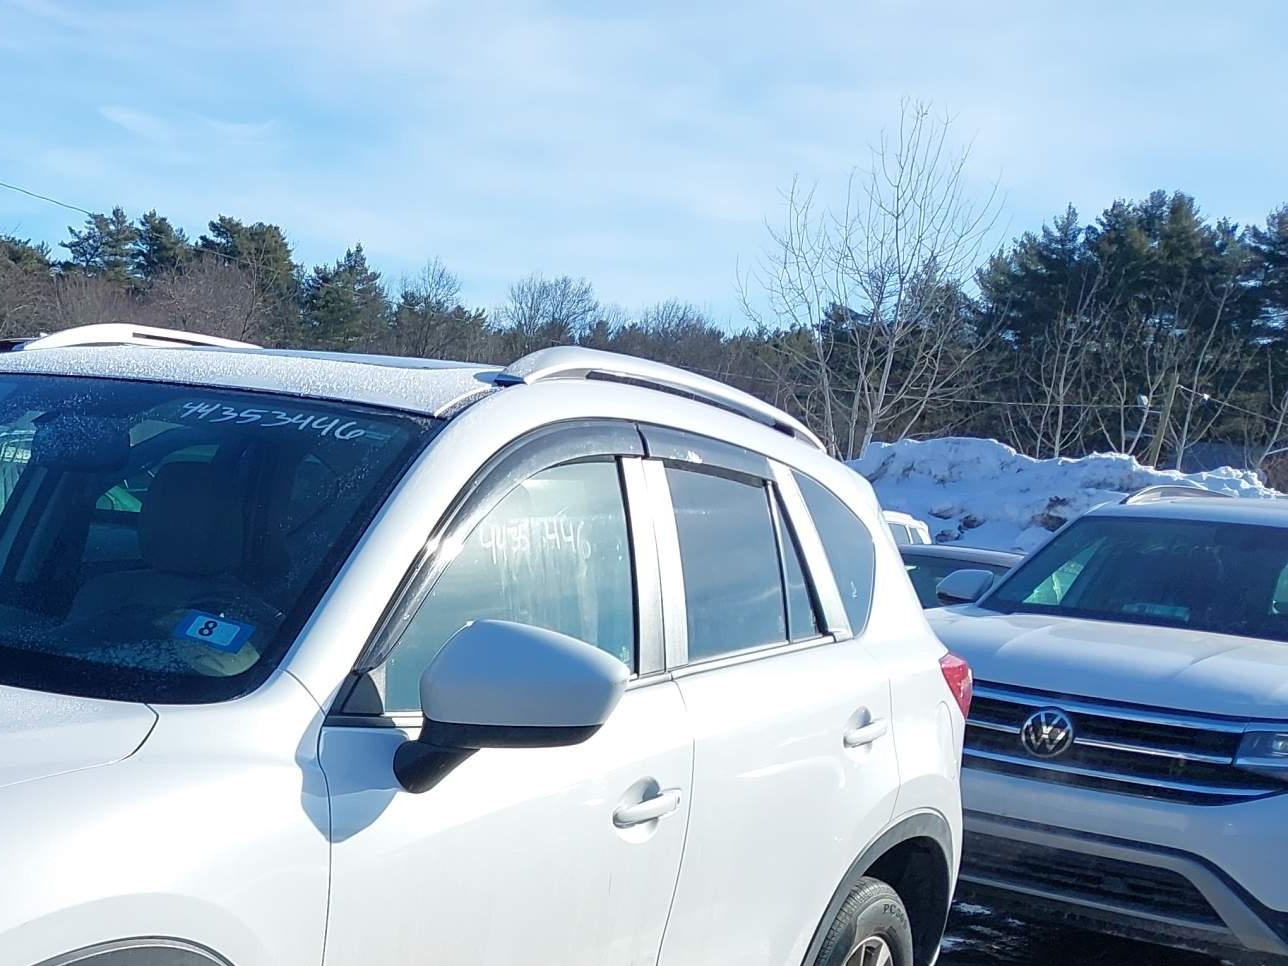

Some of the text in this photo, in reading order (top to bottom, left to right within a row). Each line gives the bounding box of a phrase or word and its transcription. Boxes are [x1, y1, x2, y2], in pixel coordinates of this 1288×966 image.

[180, 402, 367, 440] 44353446
[480, 512, 592, 564] 4435446
[198, 620, 218, 637] 8
